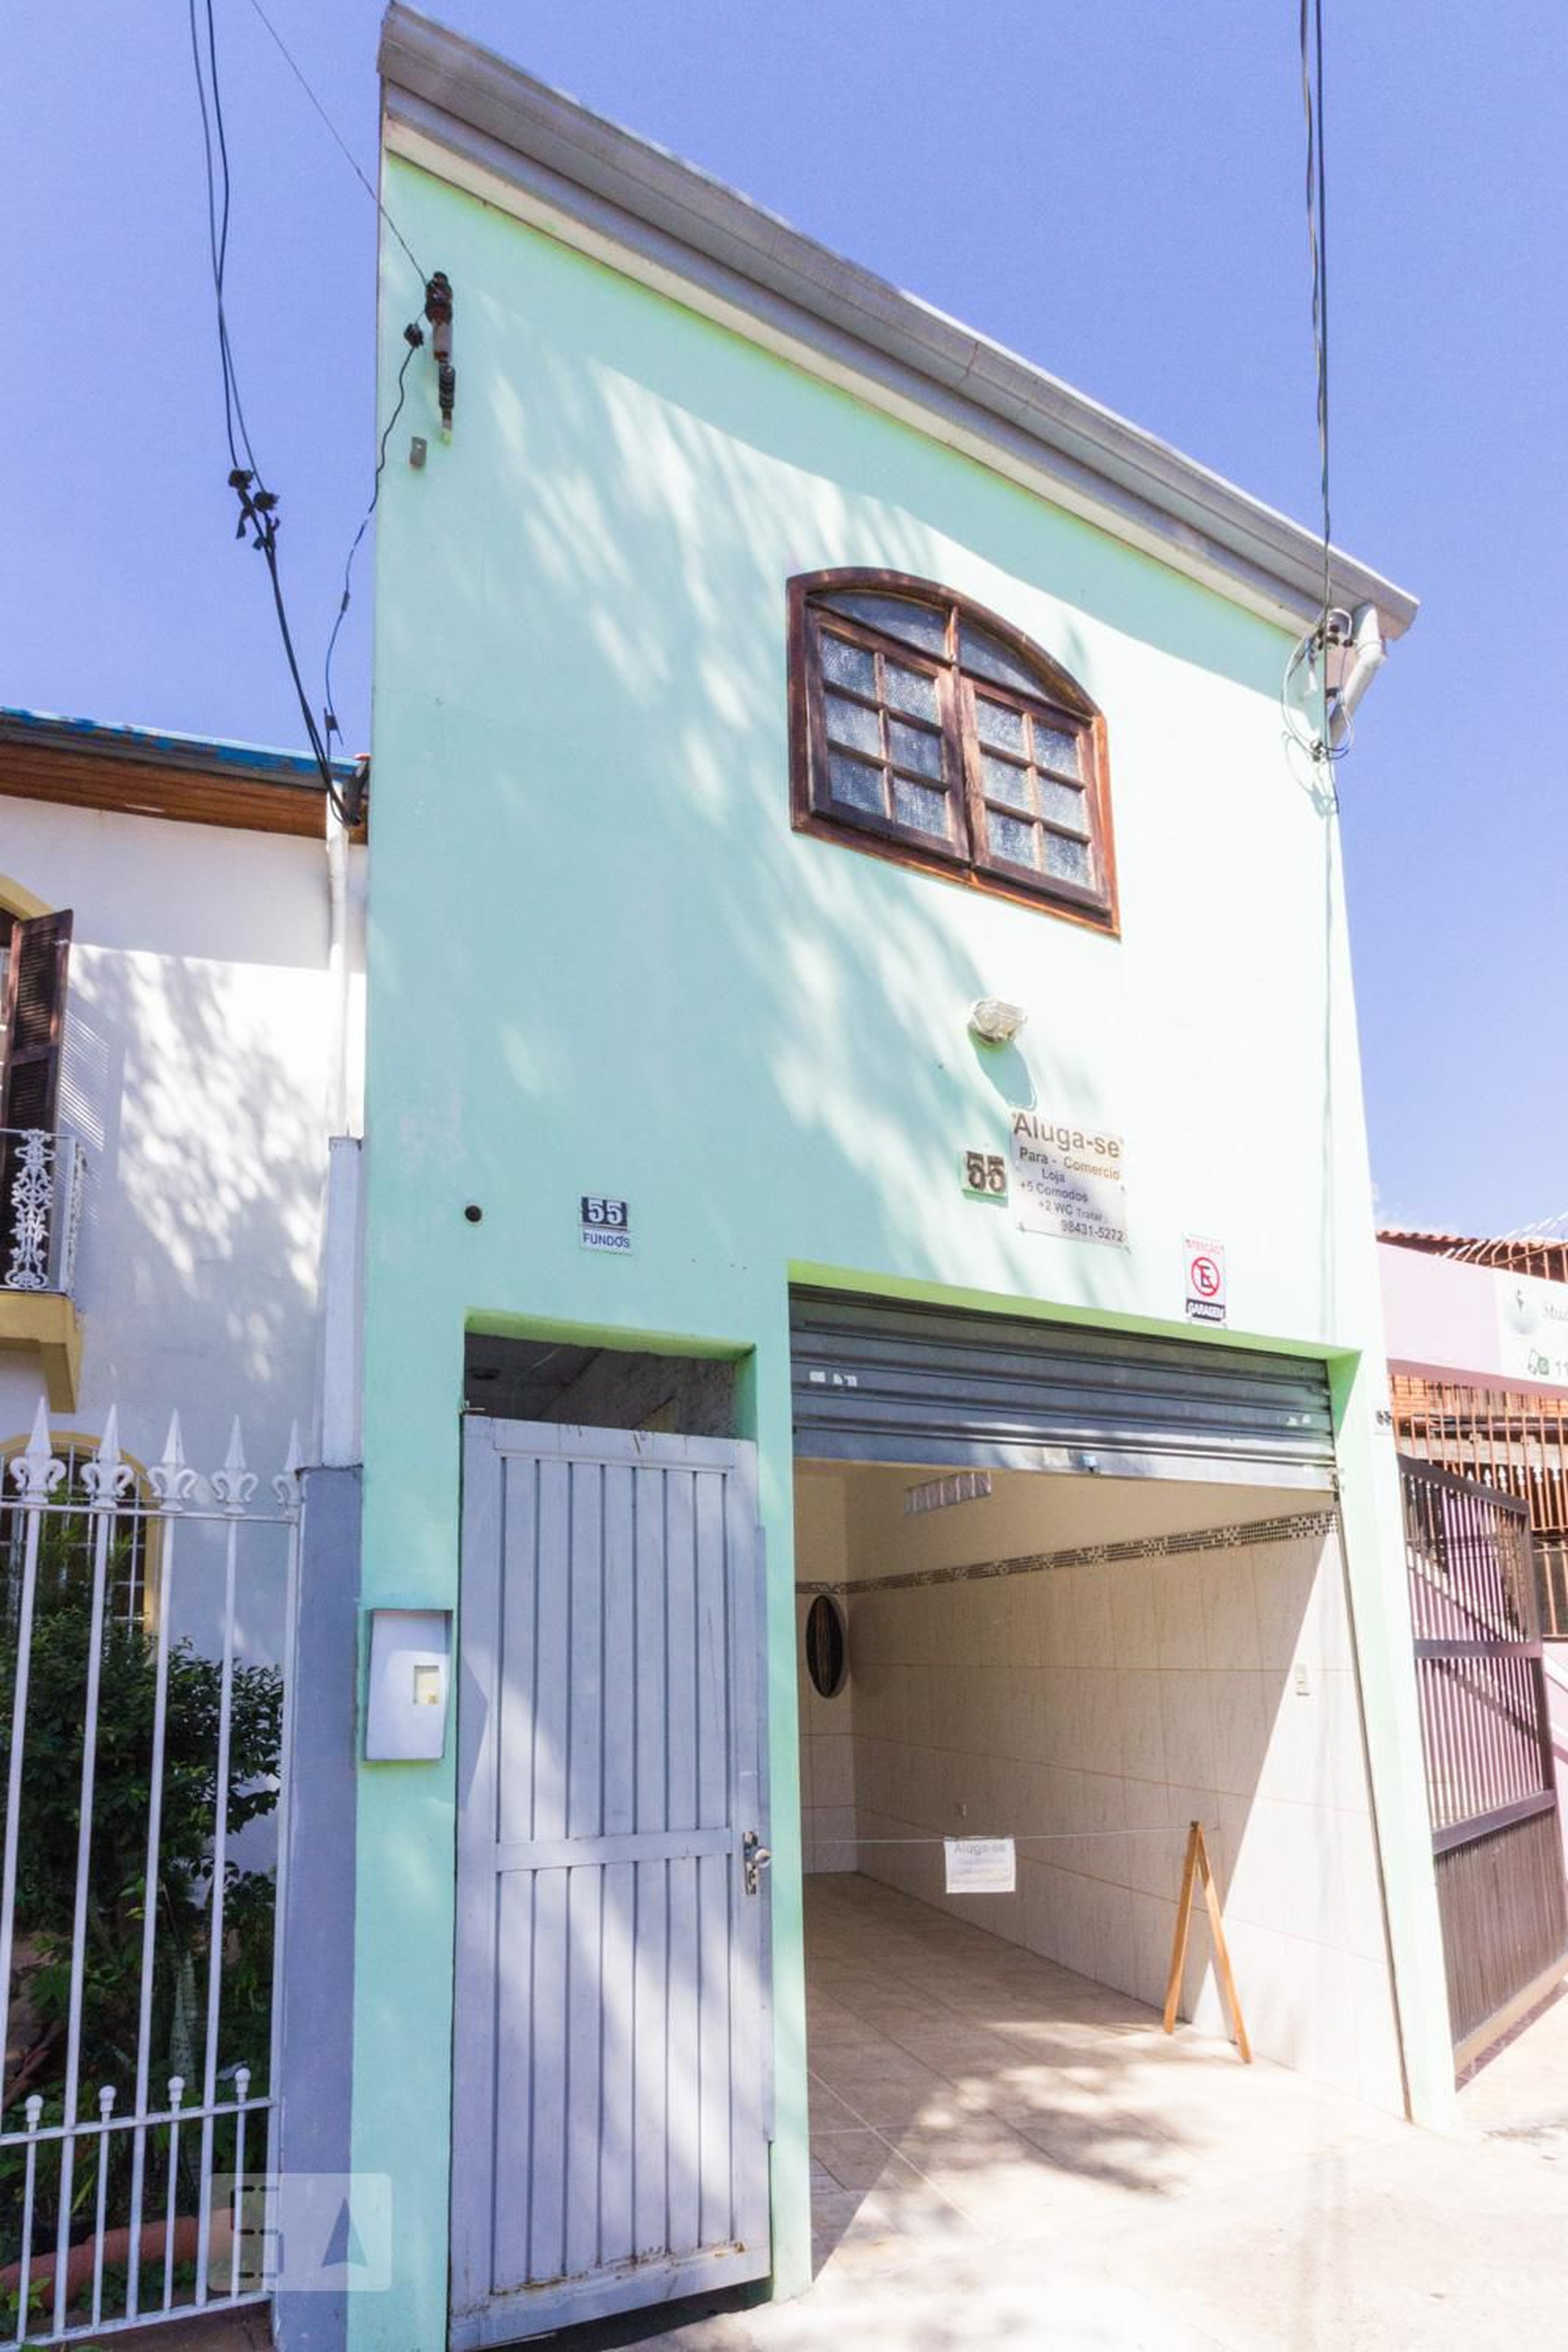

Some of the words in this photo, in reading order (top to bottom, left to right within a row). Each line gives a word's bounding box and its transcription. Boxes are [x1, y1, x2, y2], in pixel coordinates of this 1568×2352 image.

[1013, 1113, 1120, 1158] Aluga-se
[966, 1150, 1006, 1192] 55
[1020, 1146, 1048, 1165] Para
[1064, 1156, 1120, 1180] Comercio
[1042, 1168, 1065, 1185] Loja
[1036, 1182, 1088, 1203] Comodos
[588, 1198, 623, 1225] 55
[1053, 1202, 1072, 1215] WC
